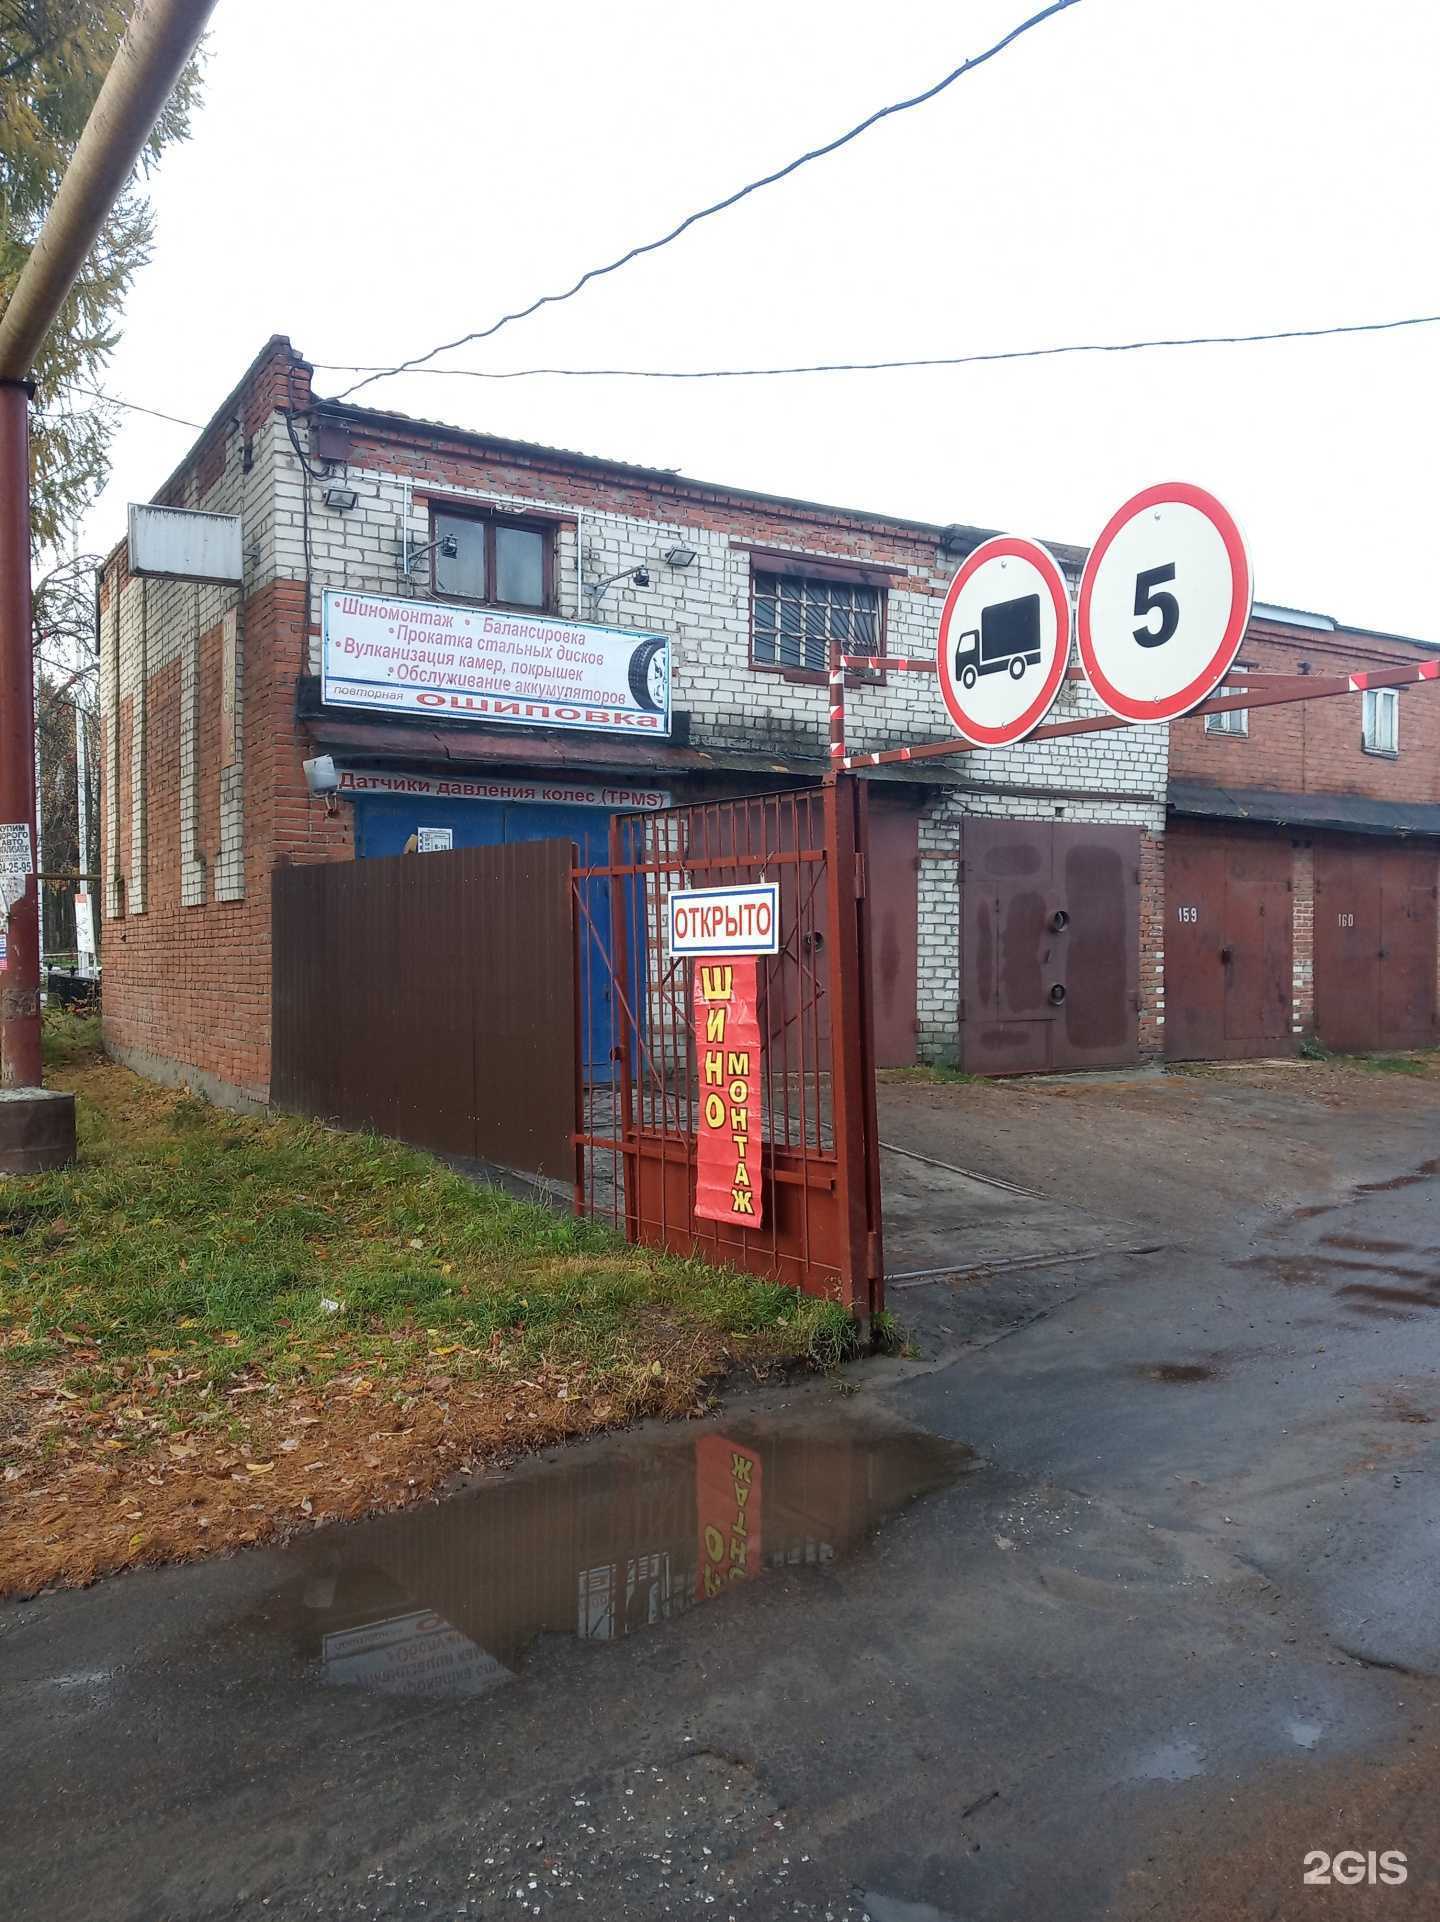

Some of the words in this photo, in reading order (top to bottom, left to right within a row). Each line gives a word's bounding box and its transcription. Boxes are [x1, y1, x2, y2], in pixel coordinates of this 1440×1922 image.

[342, 597, 453, 628] Шиномонтаж
[483, 617, 586, 646] Балансировка
[1132, 562, 1179, 648] 5
[344, 637, 454, 667] Вулканизация
[459, 656, 506, 674] камер,
[511, 660, 583, 682] покрышек
[397, 625, 473, 650] Прокатка
[477, 638, 552, 658] стальных
[556, 645, 604, 666] дисков
[334, 686, 404, 700] повторная
[397, 663, 511, 691] Обслуживание
[515, 680, 626, 705] аккумуляторов
[338, 772, 430, 793] Датчики
[437, 782, 535, 800] давления
[543, 788, 594, 803] колес
[602, 788, 664, 807] (TPMS)
[675, 902, 771, 938] ОТКРЫТО
[1178, 907, 1198, 923] 159
[1338, 914, 1354, 927] 160
[700, 964, 733, 1129] ШИНО
[727, 1050, 755, 1215] МОНТАЖ
